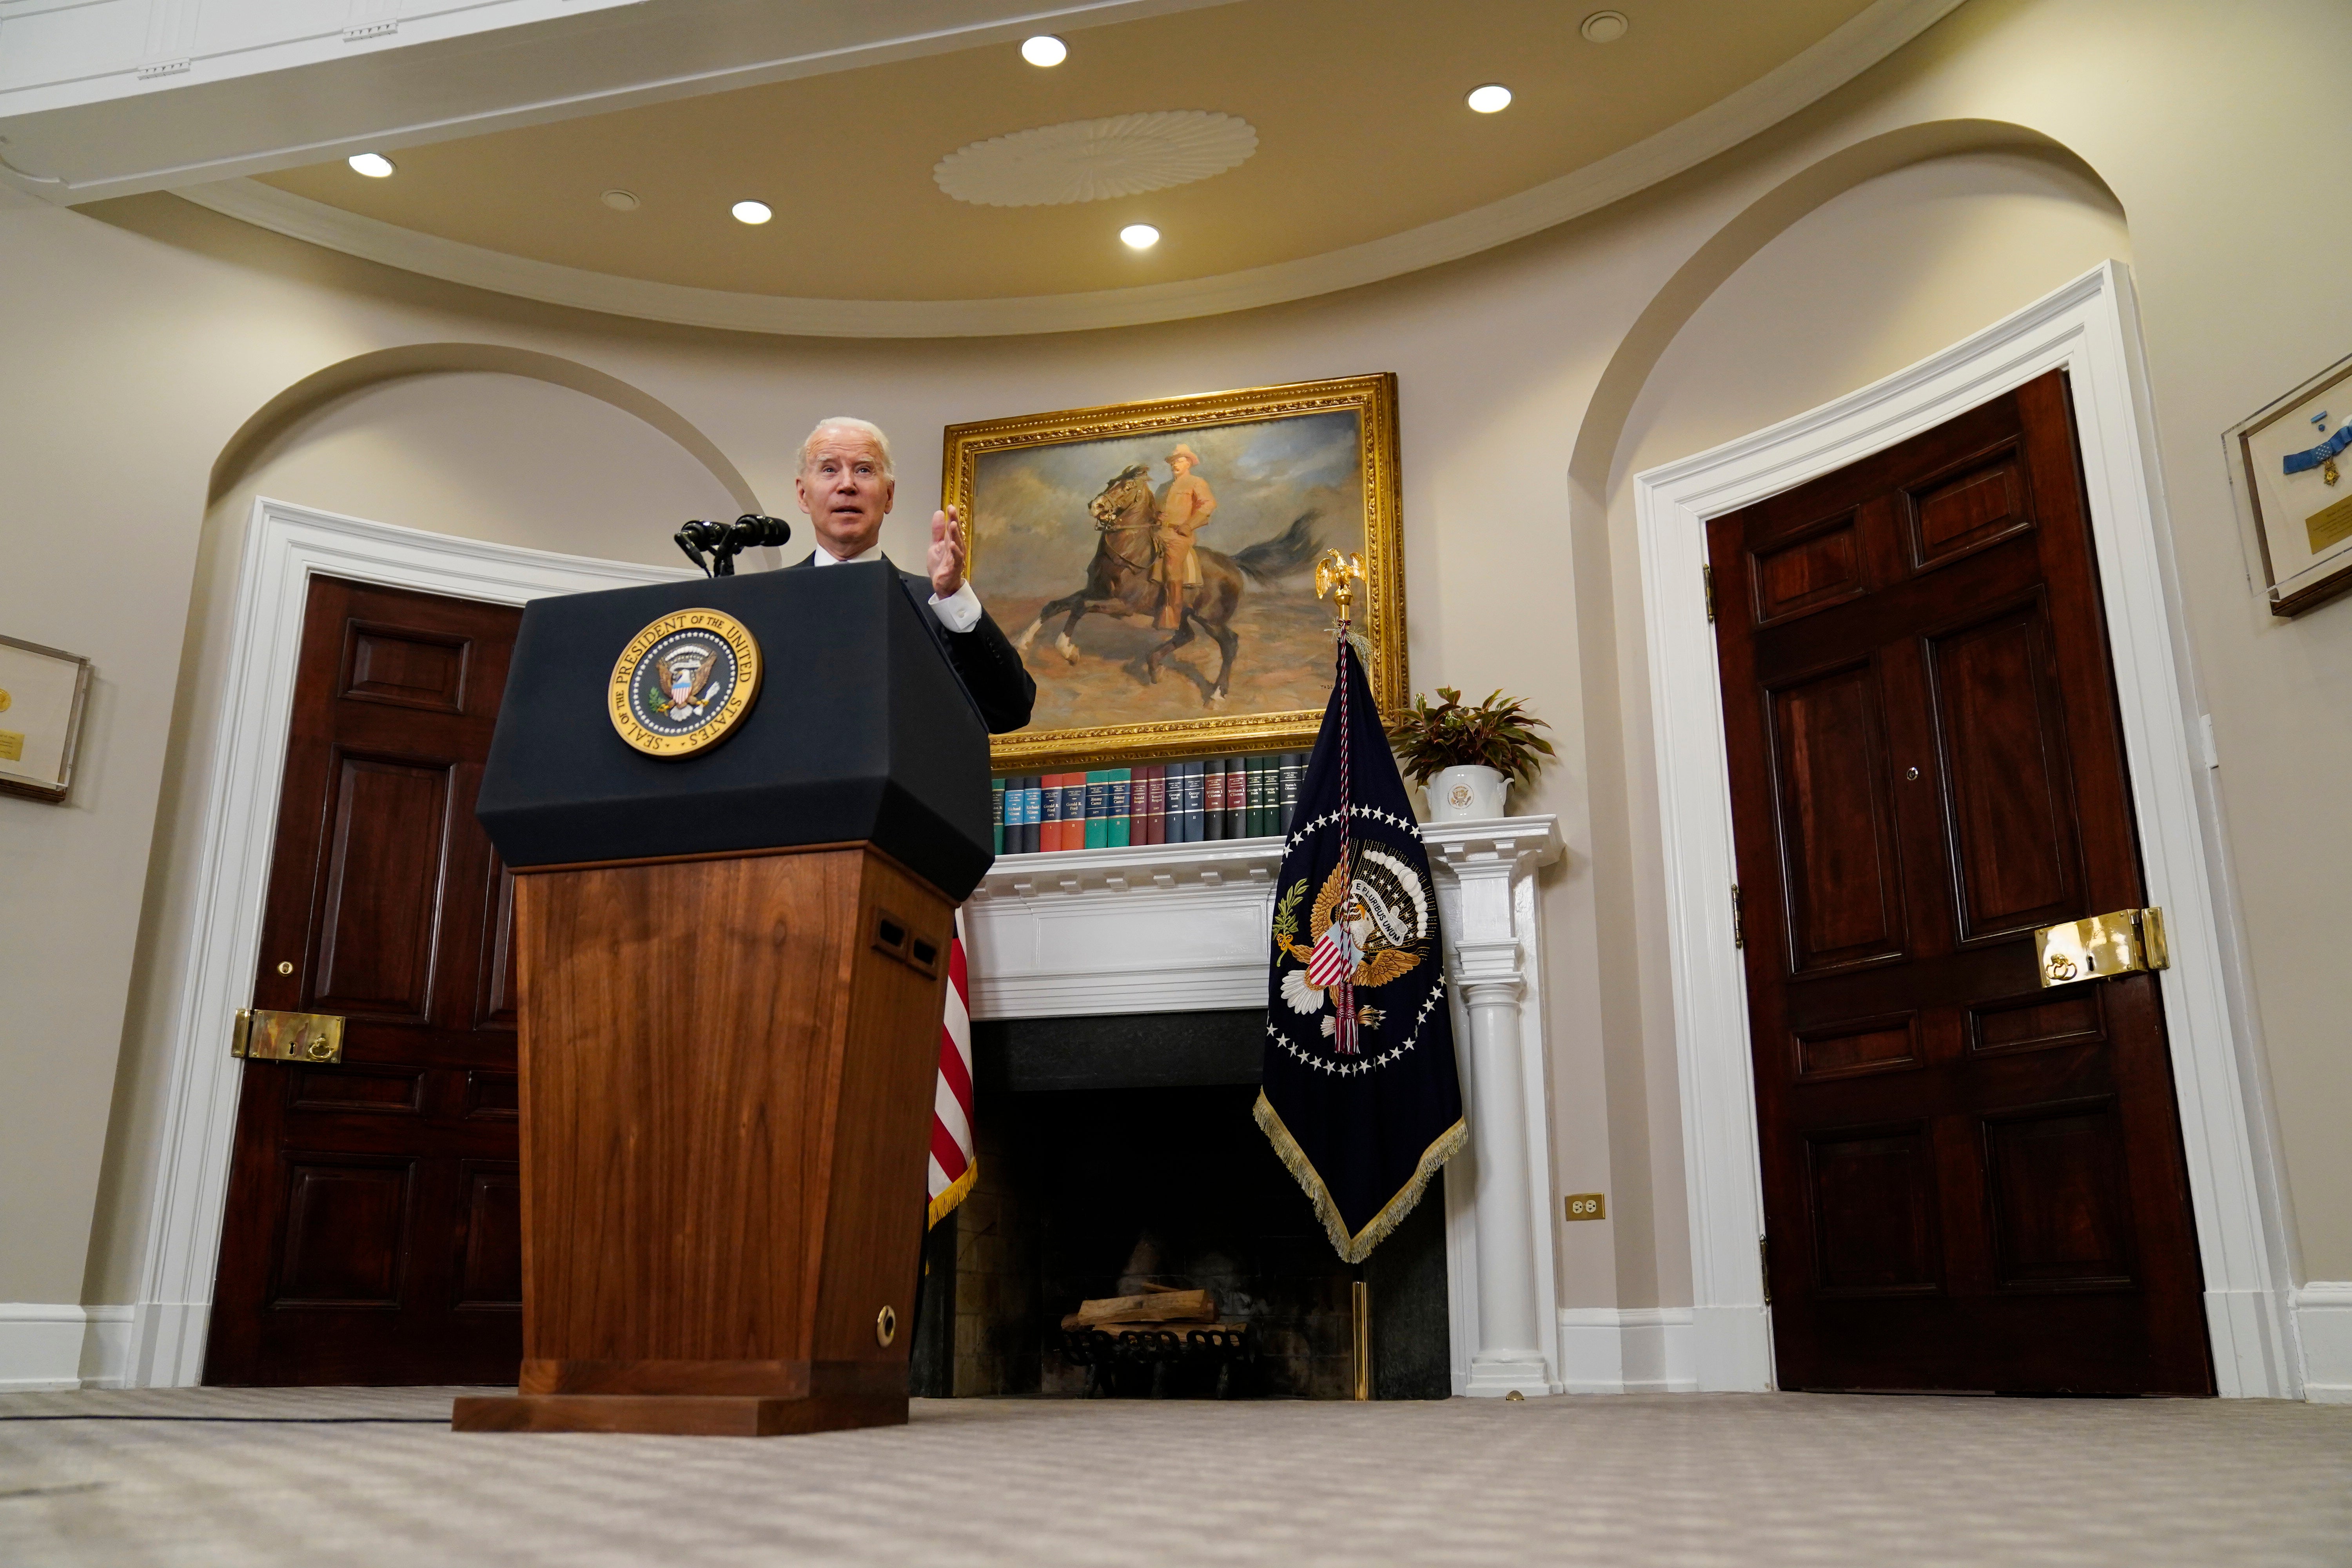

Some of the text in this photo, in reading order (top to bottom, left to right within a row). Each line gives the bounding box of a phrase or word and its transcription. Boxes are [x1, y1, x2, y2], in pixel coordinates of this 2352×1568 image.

[616, 615, 751, 750] SEAL OF THE PRESIDENT OF THE UNITED STATES
[1362, 887, 1386, 921] PLURIBUS
[1383, 920, 1400, 942] UNUM
